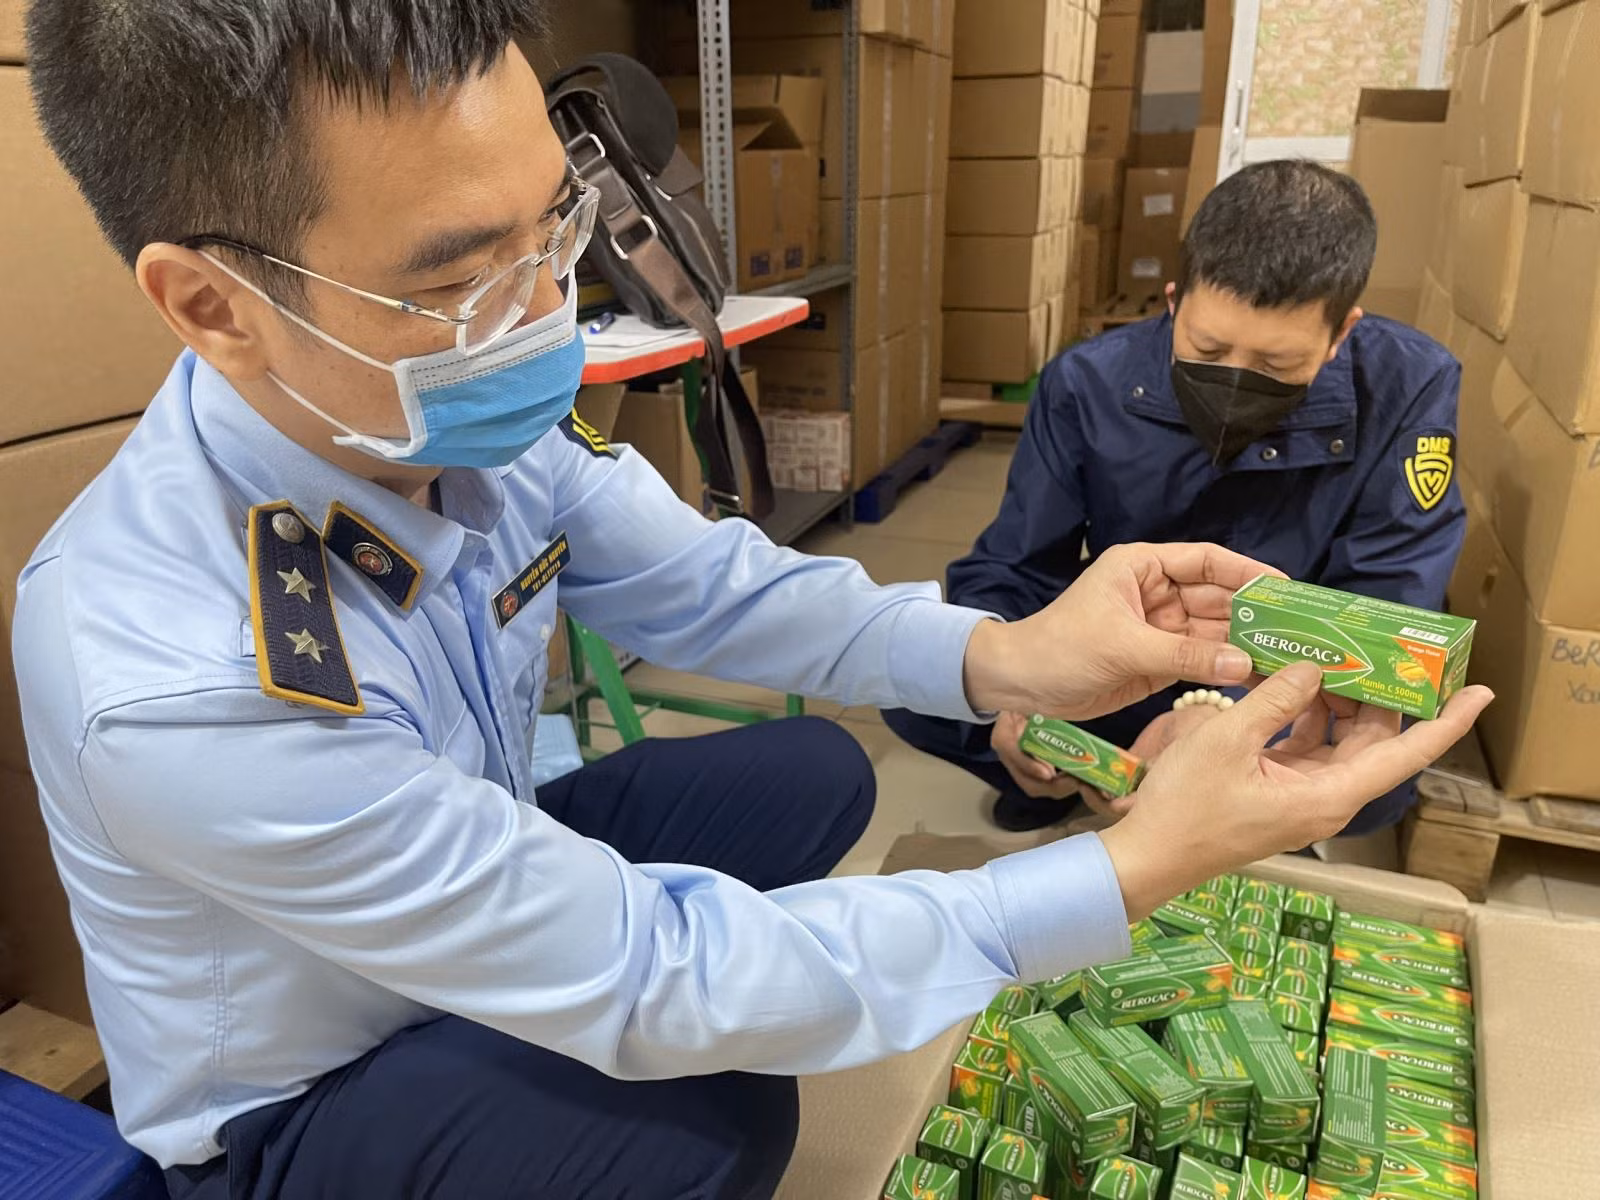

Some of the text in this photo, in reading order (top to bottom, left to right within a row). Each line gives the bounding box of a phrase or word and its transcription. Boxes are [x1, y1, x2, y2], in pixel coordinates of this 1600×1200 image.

[1417, 436, 1450, 454] DMS
[1355, 676, 1385, 691] Vitamin
[1394, 687, 1423, 703] 500mg
